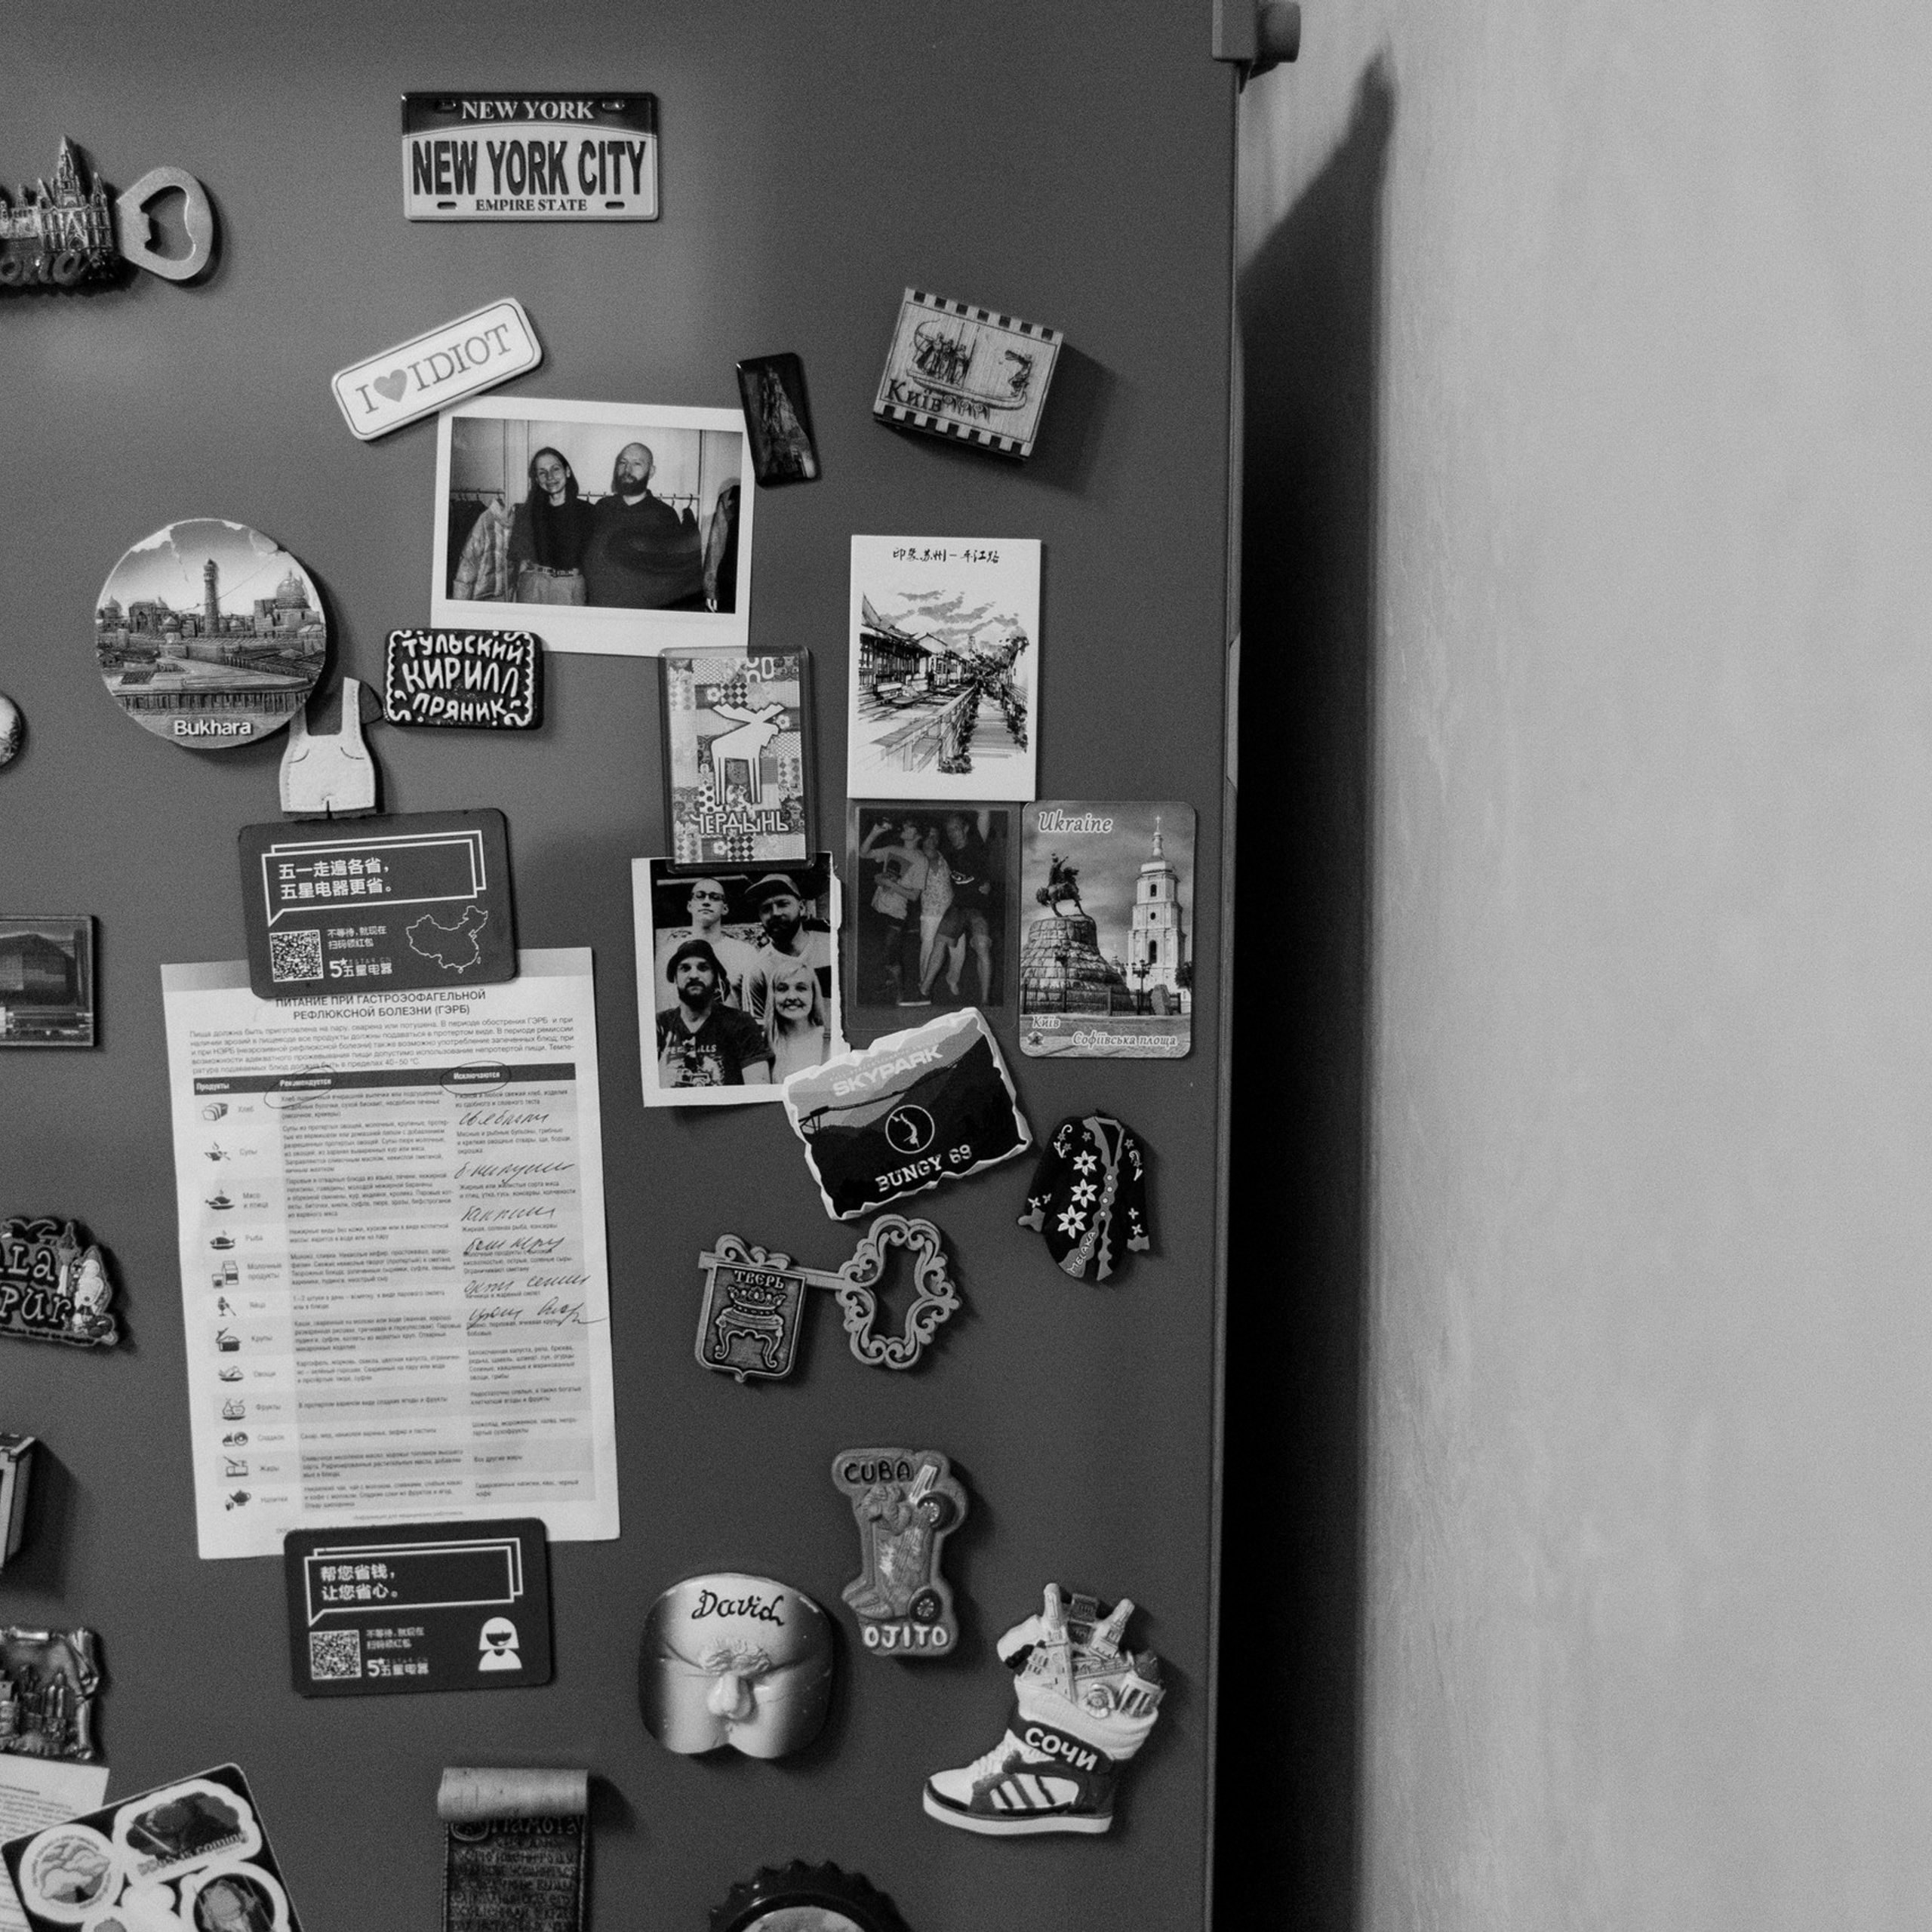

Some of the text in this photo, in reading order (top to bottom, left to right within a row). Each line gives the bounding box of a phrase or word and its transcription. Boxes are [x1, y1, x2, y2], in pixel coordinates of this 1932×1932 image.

[462, 100, 595, 119] NEW YORK
[413, 140, 646, 195] NEW YORK CITY
[475, 198, 587, 211] EMPIRE STATE
[355, 323, 511, 414] I IDIOT
[885, 378, 943, 413] Київ
[402, 657, 519, 698] КИРИЛЛ
[412, 692, 508, 721] ПРЯНИК
[174, 718, 253, 737] Bukhara
[690, 811, 789, 835] ЧЕРДЫНЬ
[1038, 809, 1113, 833] Ukraine
[275, 997, 327, 1008] ПИТАНИЕ
[331, 995, 352, 1005] ПРИ
[293, 1004, 469, 1018] РЕФЛЮКСНОЙ БОЛЕЗНИ (ГЭРБ)
[213, 1029, 242, 1038] должна
[448, 1020, 479, 1028] периоде
[481, 1017, 525, 1027] обострения
[528, 1016, 547, 1024] ГЭРБ
[559, 1016, 573, 1024] при
[1032, 1015, 1060, 1029] Київ
[312, 1034, 349, 1043] продукты
[433, 1029, 473, 1038] протертом
[504, 1027, 534, 1035] периоде
[1137, 1035, 1178, 1048] площа
[832, 1044, 943, 1097] SKYPARK
[875, 1143, 972, 1193] BUNGY 69
[1066, 1230, 1097, 1274] MELAKA
[844, 1460, 911, 1484] CUBA
[691, 1589, 785, 1626] David
[1025, 1727, 1099, 1772] СОЧИ
